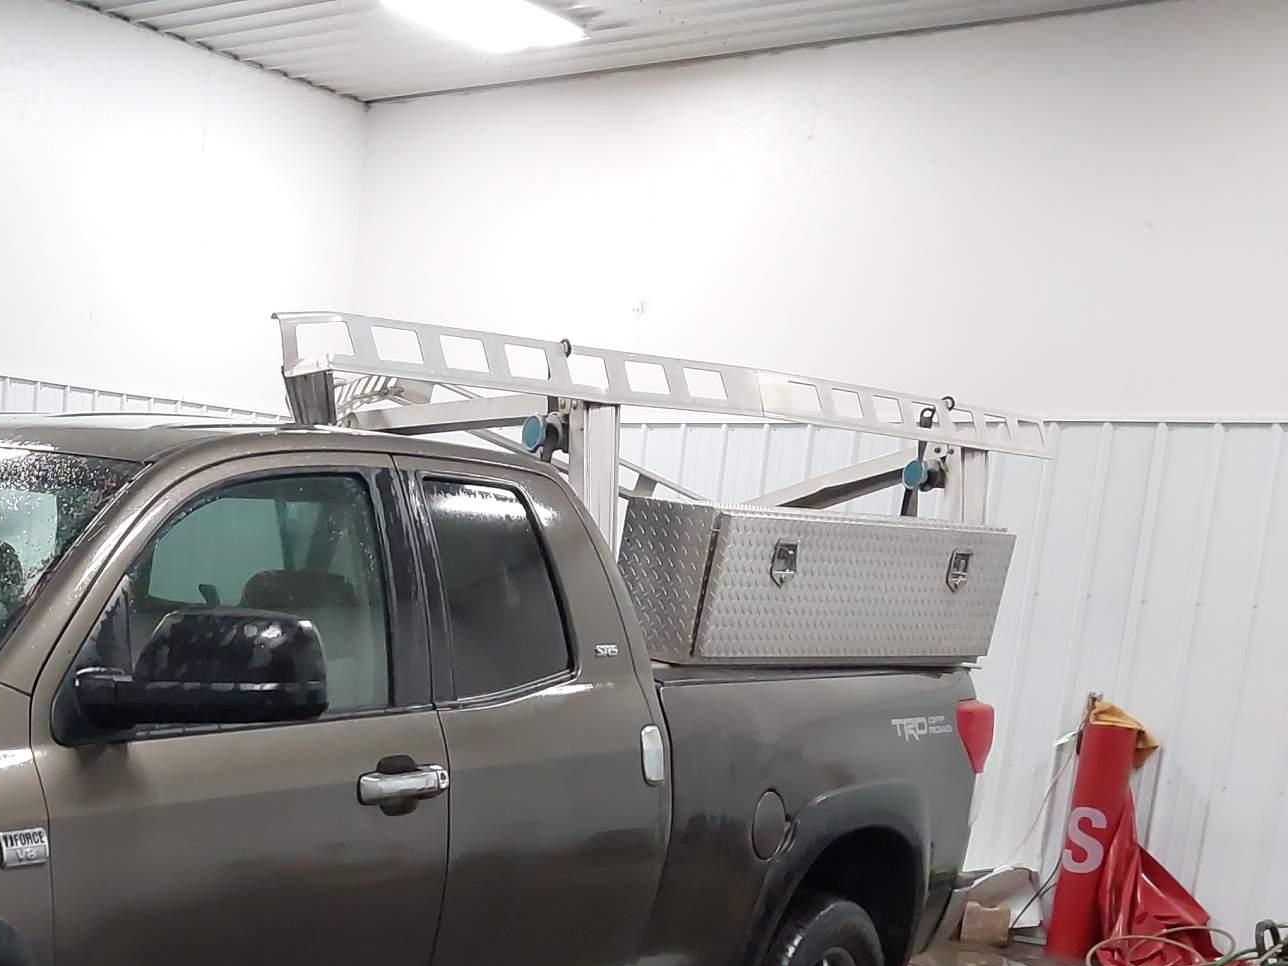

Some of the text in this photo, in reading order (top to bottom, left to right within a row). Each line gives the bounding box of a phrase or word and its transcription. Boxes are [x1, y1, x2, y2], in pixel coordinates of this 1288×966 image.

[891, 717, 927, 741] TRD
[1062, 807, 1107, 874] S
[16, 848, 37, 862] V8
